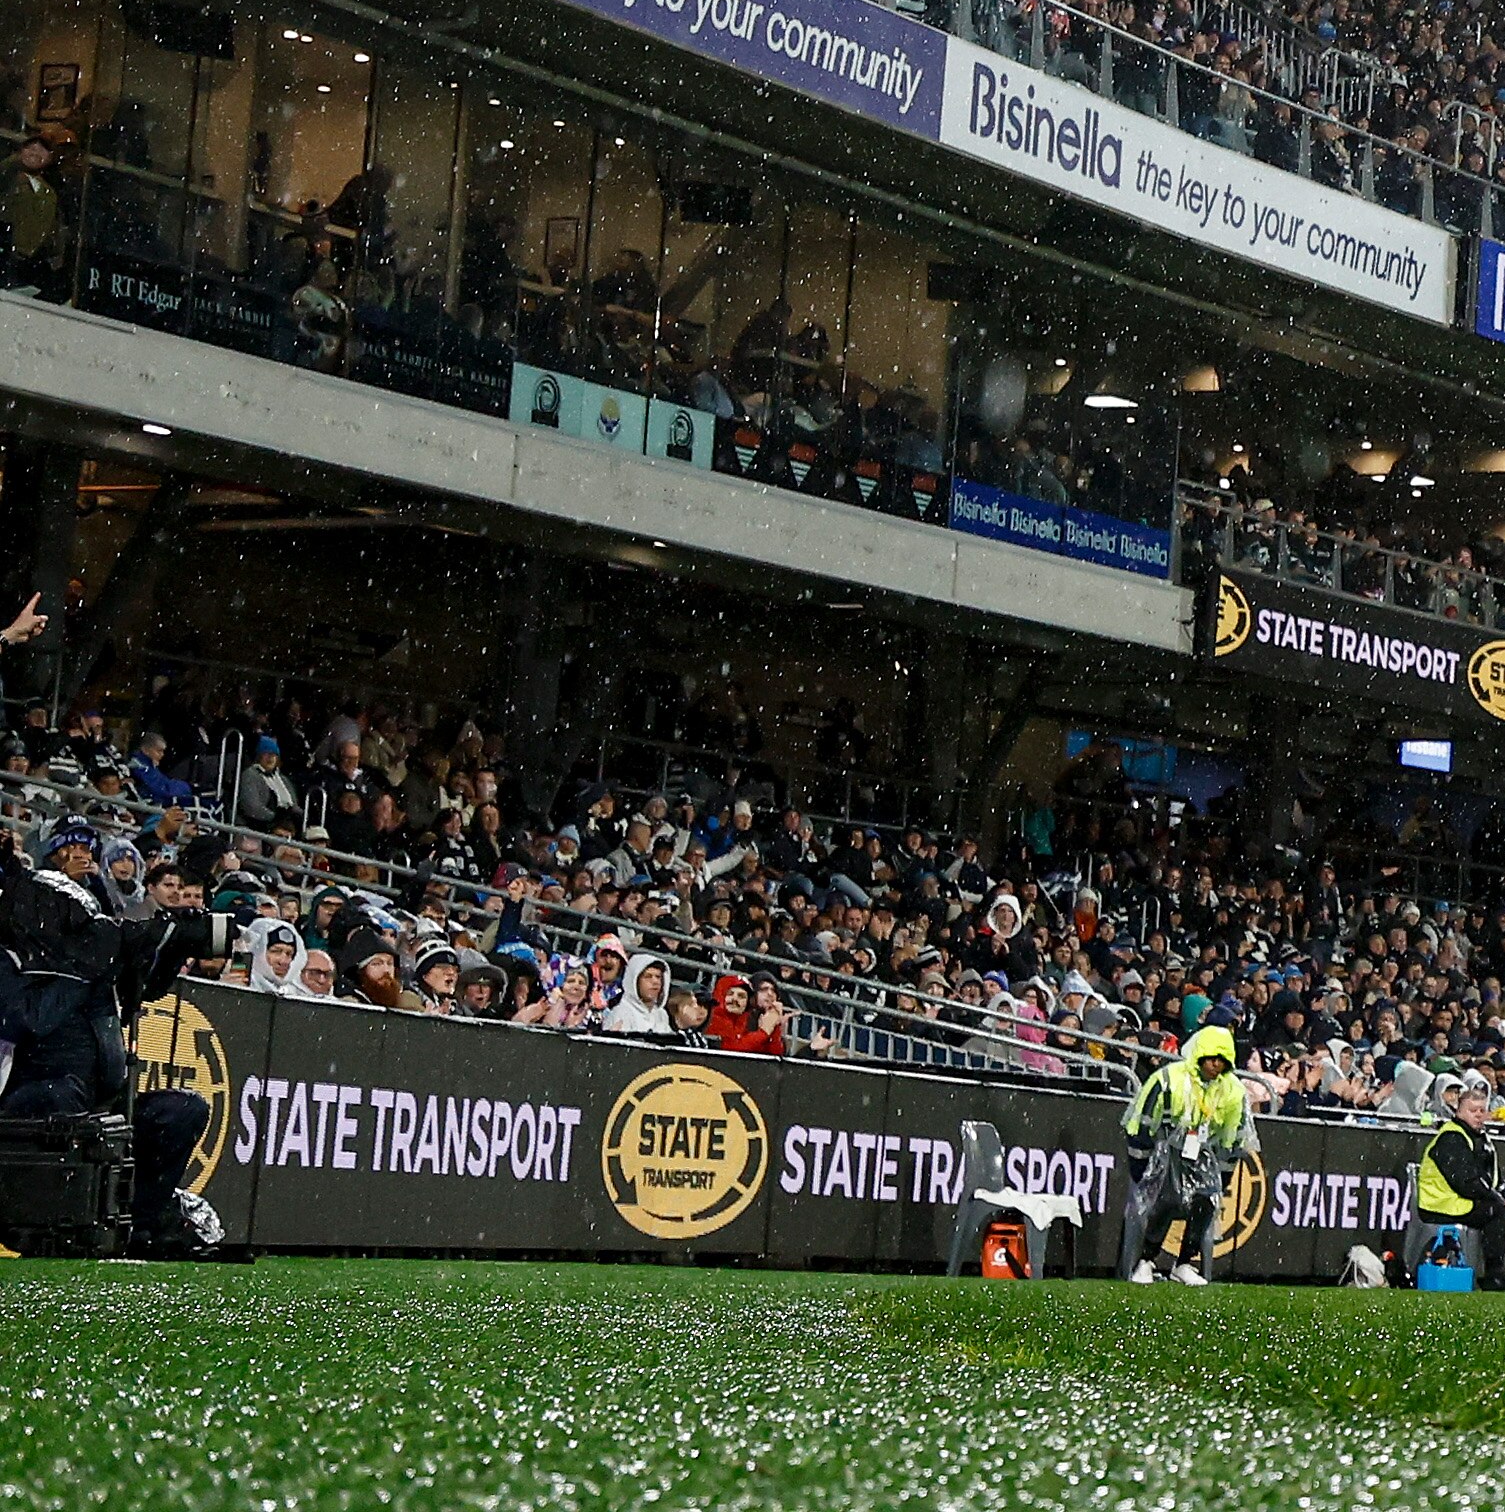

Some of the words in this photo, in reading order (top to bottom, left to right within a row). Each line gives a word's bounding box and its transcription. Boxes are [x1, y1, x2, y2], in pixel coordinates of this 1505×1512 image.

[765, 11, 923, 112] community
[970, 61, 1122, 188] Bisinella
[1136, 149, 1171, 200] the
[1176, 165, 1219, 223] key
[1221, 183, 1246, 227] to
[1251, 202, 1304, 253] your
[1306, 227, 1426, 301] community
[111, 273, 136, 297] RT
[138, 281, 182, 312] Edgar
[954, 493, 1006, 527] Bisinella
[1010, 508, 1060, 541] Bisinella
[1066, 519, 1116, 554] Bisinella
[1120, 535, 1168, 566] Bisinella
[1257, 609, 1323, 650] STATE
[1329, 624, 1460, 685] TRANSPORT
[234, 1074, 361, 1169] STATE
[370, 1088, 581, 1182] TRANSPORT
[638, 1114, 727, 1160] STATE
[642, 1167, 716, 1190] TRANSPORT
[780, 1124, 901, 1202] STATE
[908, 1137, 1114, 1214] TRASPORT
[1272, 1169, 1360, 1231] STATE
